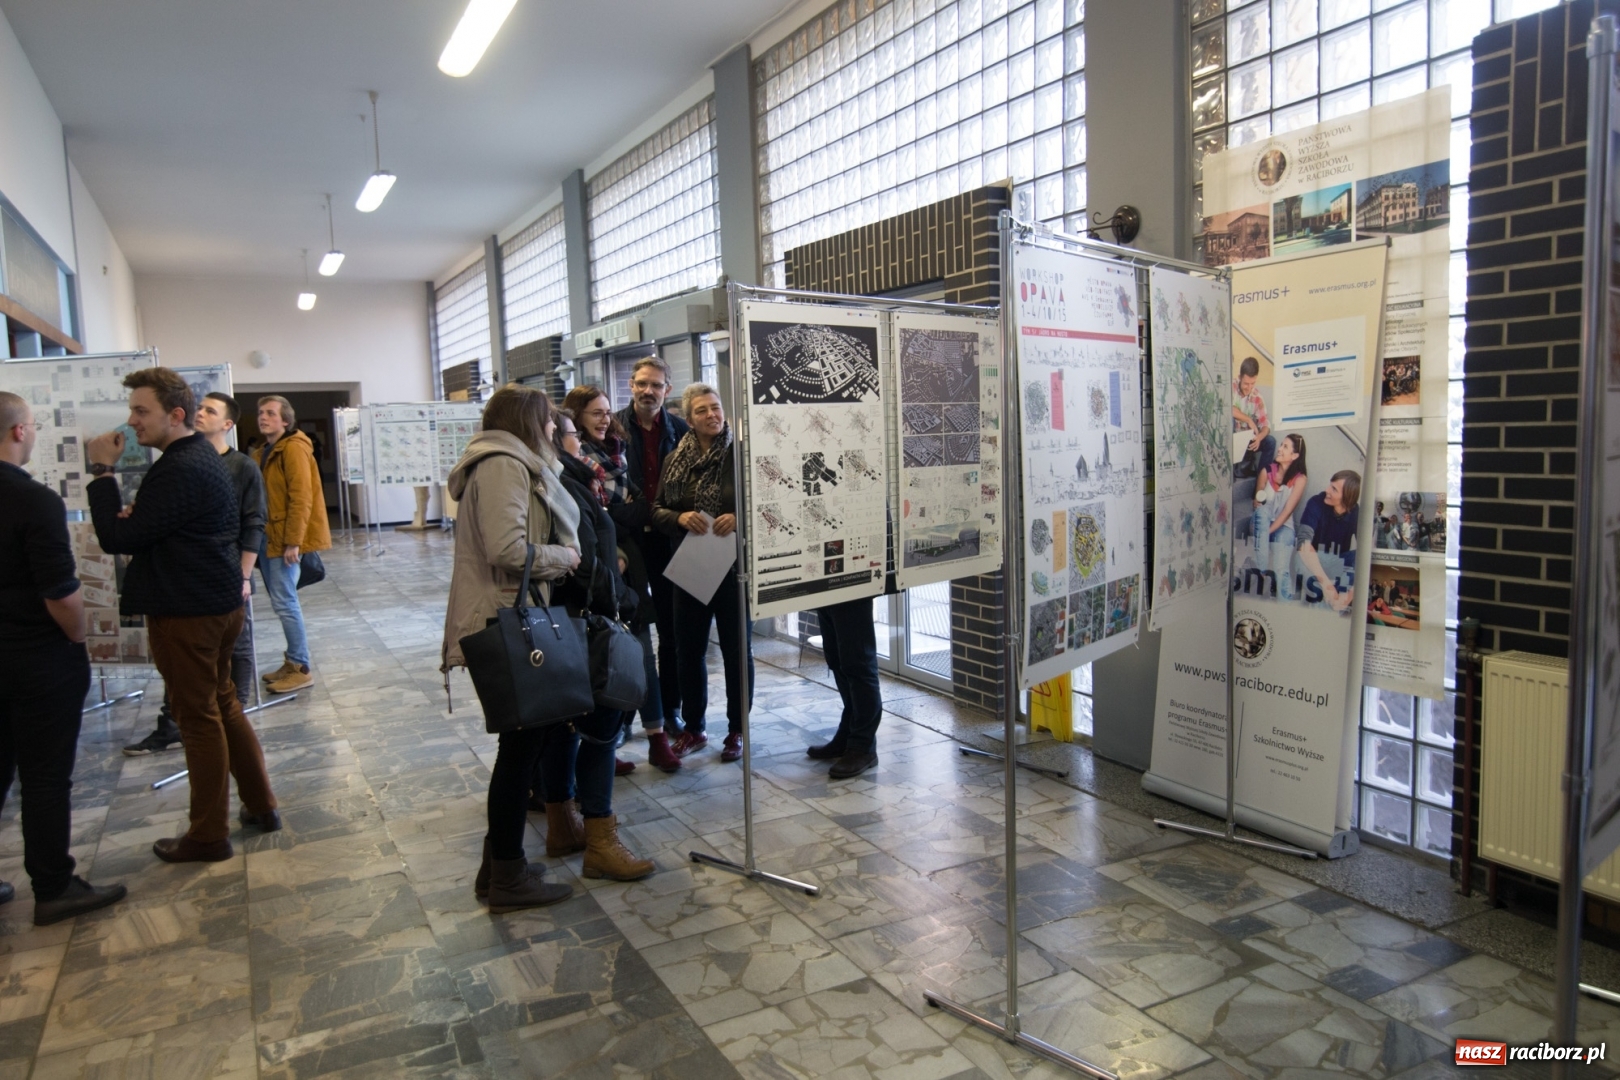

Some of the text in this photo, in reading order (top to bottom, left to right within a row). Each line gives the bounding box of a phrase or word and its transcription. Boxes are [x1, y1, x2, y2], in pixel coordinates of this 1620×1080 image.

[1298, 141, 1330, 155] WYŻSZA
[1298, 151, 1329, 165] SZKOŁA
[1298, 155, 1349, 174] ZAWODOWA
[1306, 163, 1354, 182] RACIBORZU
[1019, 268, 1064, 285] WORKSHOP
[1020, 281, 1066, 307] OPAVA
[1232, 279, 1377, 306] rasmus+ www.erasmus.org.pl
[1282, 340, 1338, 355] Erasmus+
[1174, 660, 1329, 707] www.pwsraciborz.edu.pl
[1169, 699, 1186, 710] Biuro
[1167, 711, 1197, 725] programu
[1272, 727, 1307, 743] Erasmus+
[1253, 734, 1325, 761] Szkolnictwo Wyższe
